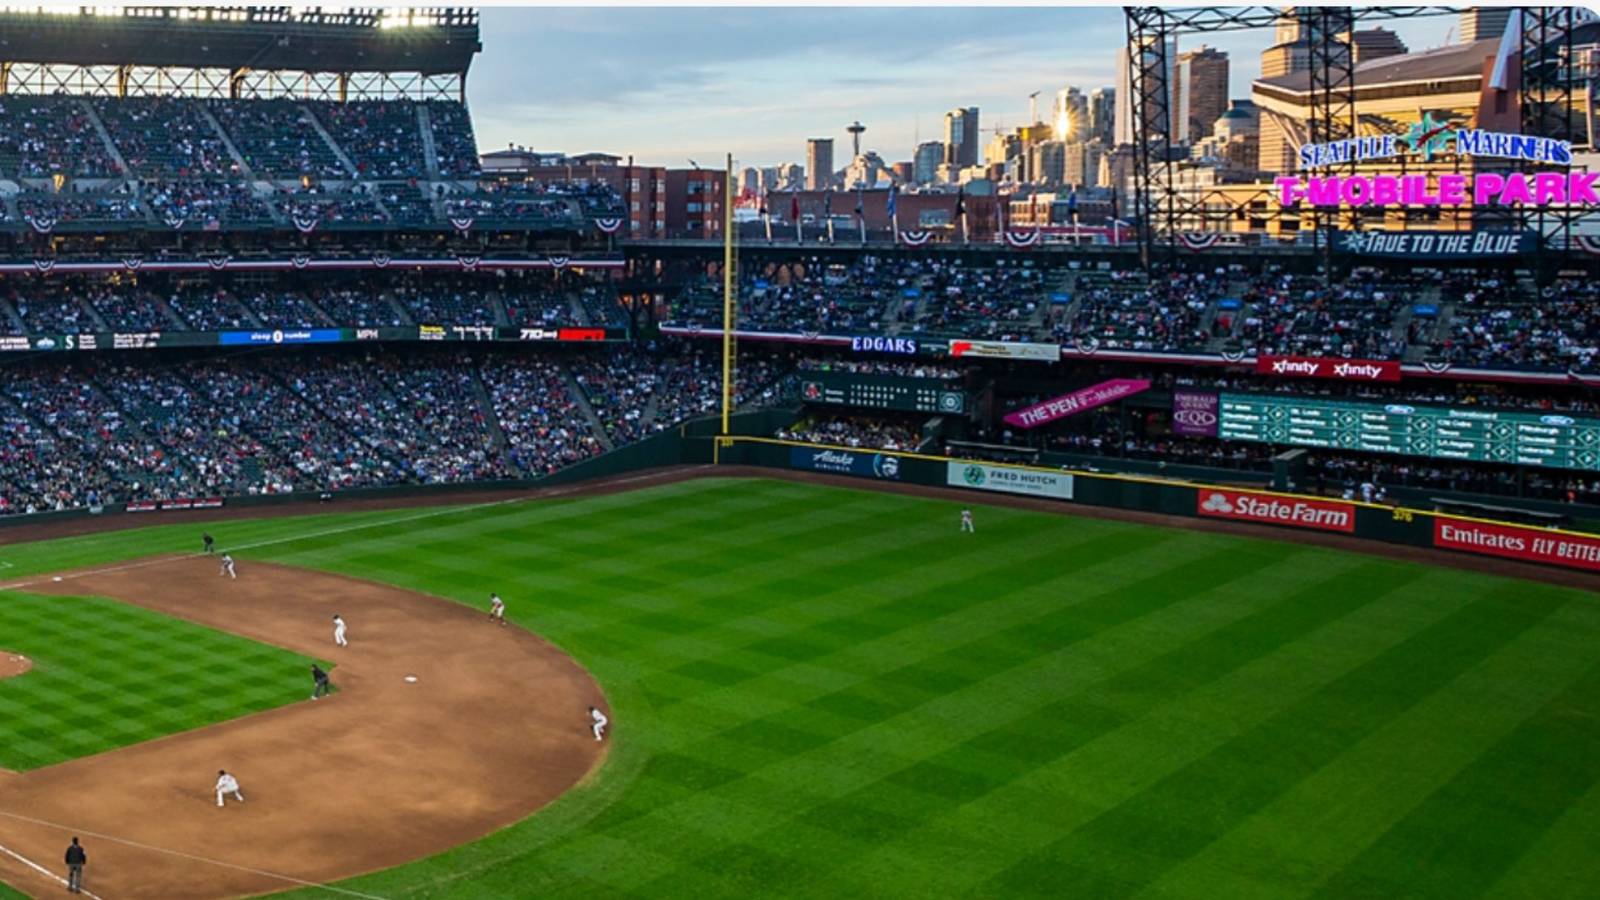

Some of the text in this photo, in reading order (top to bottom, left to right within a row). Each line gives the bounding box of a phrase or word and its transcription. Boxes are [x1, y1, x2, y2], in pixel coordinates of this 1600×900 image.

[1300, 129, 1573, 170] SEATTLE MARINERS
[1274, 172, 1600, 206] T-MOBILE PARK
[1366, 231, 1522, 253] TRUE TO THE BLUE
[356, 329, 378, 339] MPH
[852, 336, 916, 354] EDGARS
[1272, 359, 1382, 378] xfinity xfinity
[1019, 396, 1079, 425] THE PEN
[812, 450, 854, 465] Alaska
[990, 471, 1018, 481] FRED
[1021, 475, 1057, 485] HUTCH
[1441, 525, 1525, 551] Emirates
[1532, 538, 1557, 555] FLY
